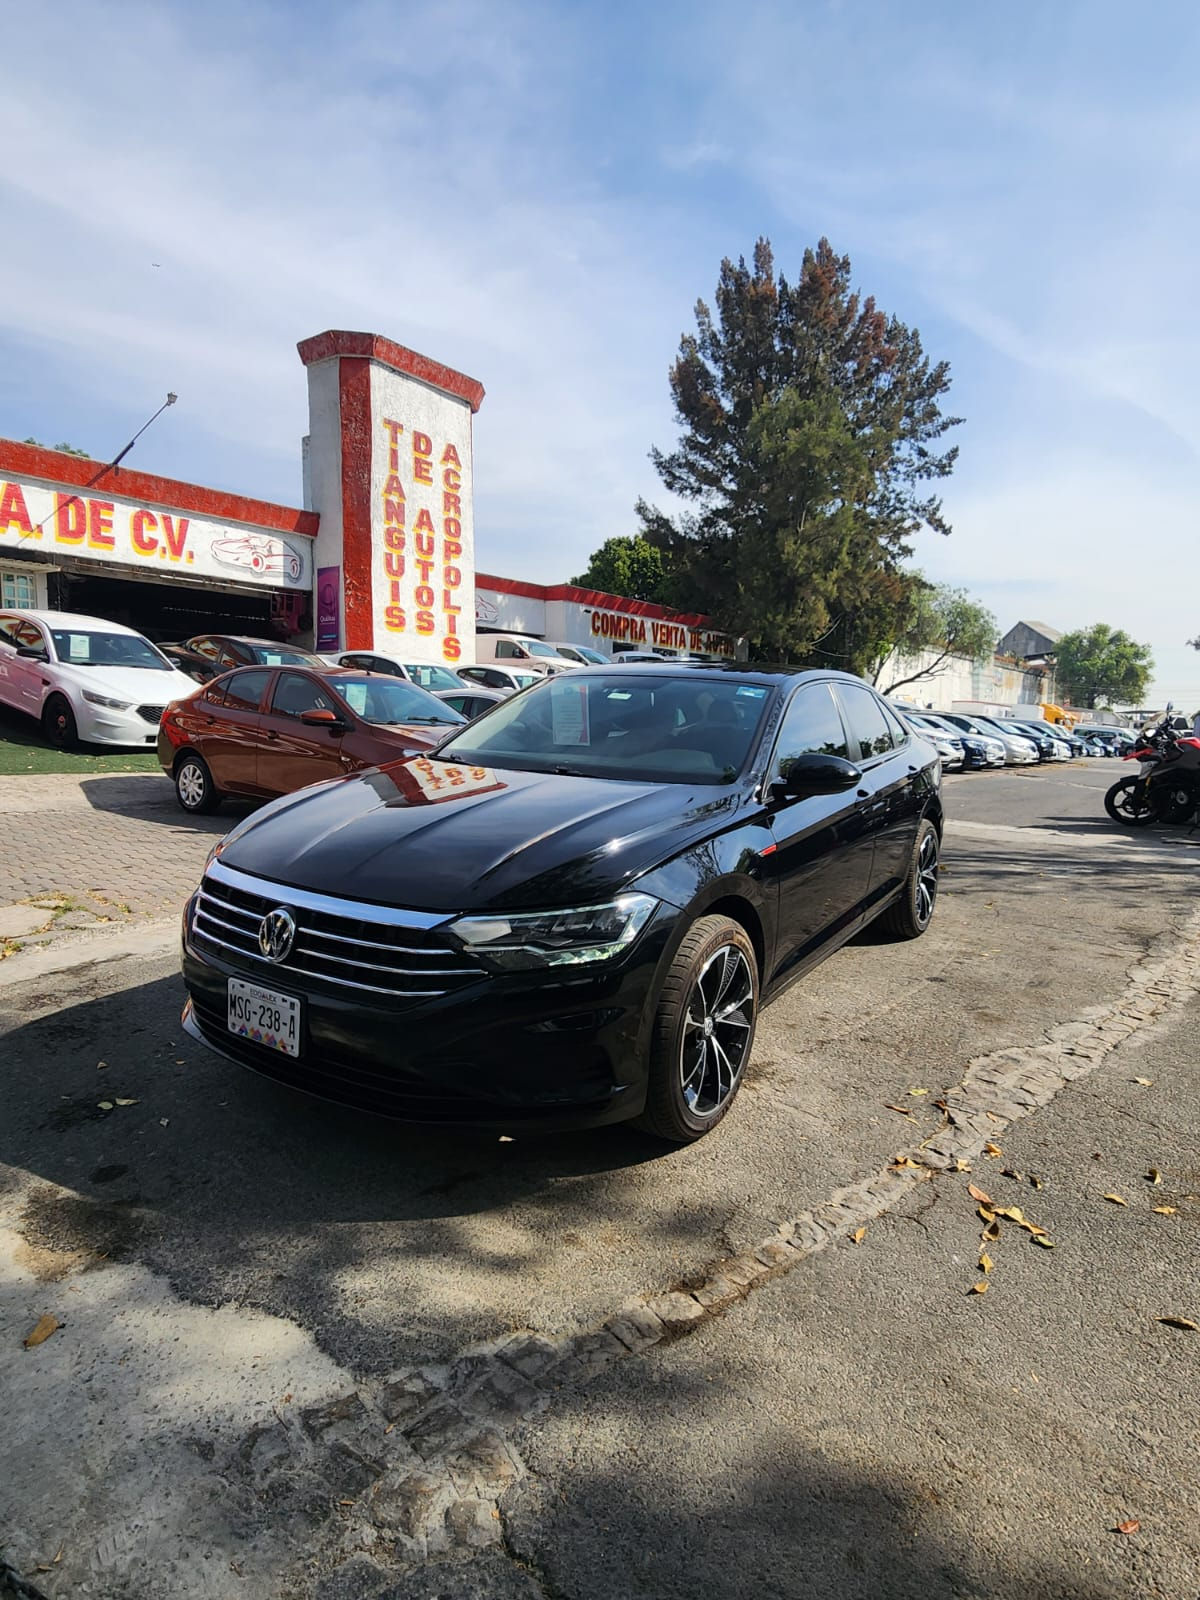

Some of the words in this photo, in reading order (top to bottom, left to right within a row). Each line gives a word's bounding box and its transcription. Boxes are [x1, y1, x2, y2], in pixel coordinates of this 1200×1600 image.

[413, 430, 433, 486] DE
[53, 492, 115, 550] DE
[130, 510, 194, 564] C.V.
[382, 418, 406, 632] TIANGUIS
[412, 508, 435, 636] AUTOS
[440, 443, 462, 661] ACROPOLIS
[591, 611, 647, 644] COMPRA
[651, 622, 686, 649] VENTA
[690, 632, 702, 650] DE
